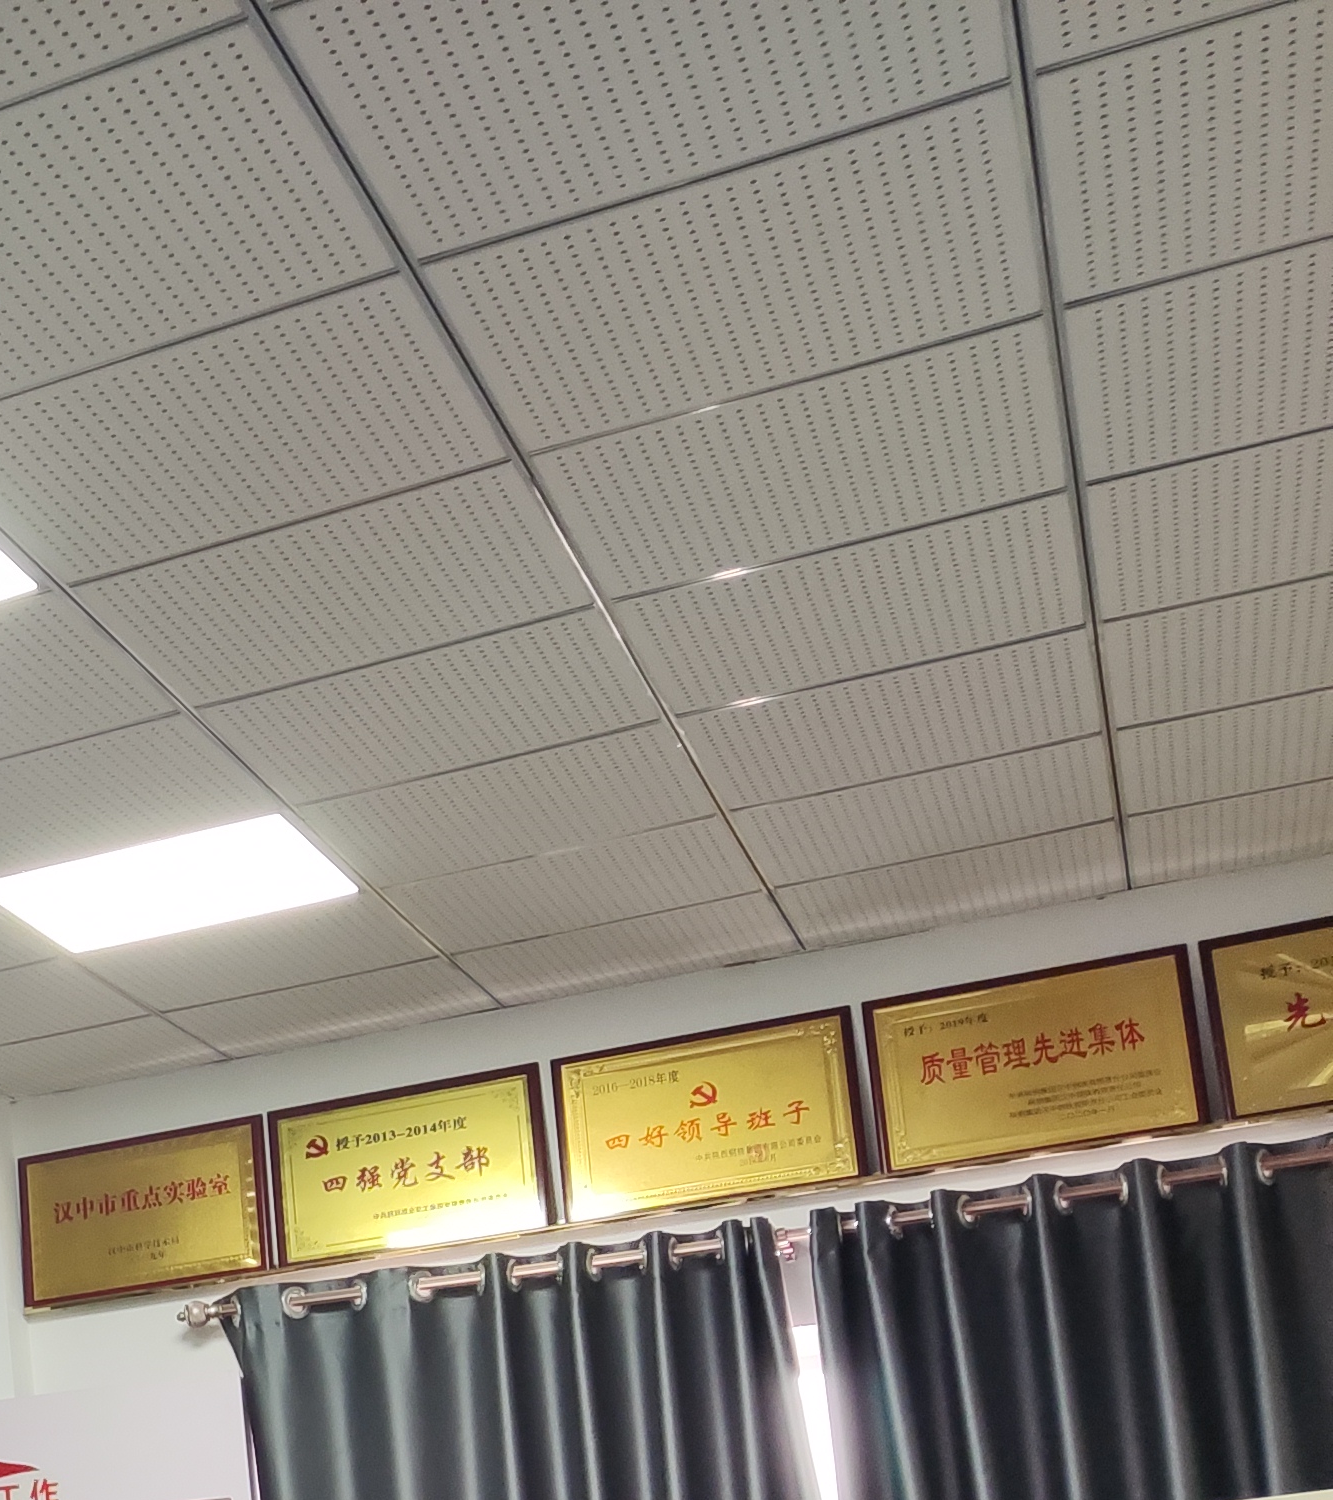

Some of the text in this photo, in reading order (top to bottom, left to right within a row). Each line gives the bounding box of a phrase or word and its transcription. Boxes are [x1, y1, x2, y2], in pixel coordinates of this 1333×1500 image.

[1284, 992, 1326, 1032] 先
[920, 1017, 1145, 1086] 质量管理先进集体
[605, 1100, 810, 1150] 四好领导班子
[322, 1146, 490, 1194] 四强党支部
[54, 1173, 232, 1225] 汉中市重点实验室
